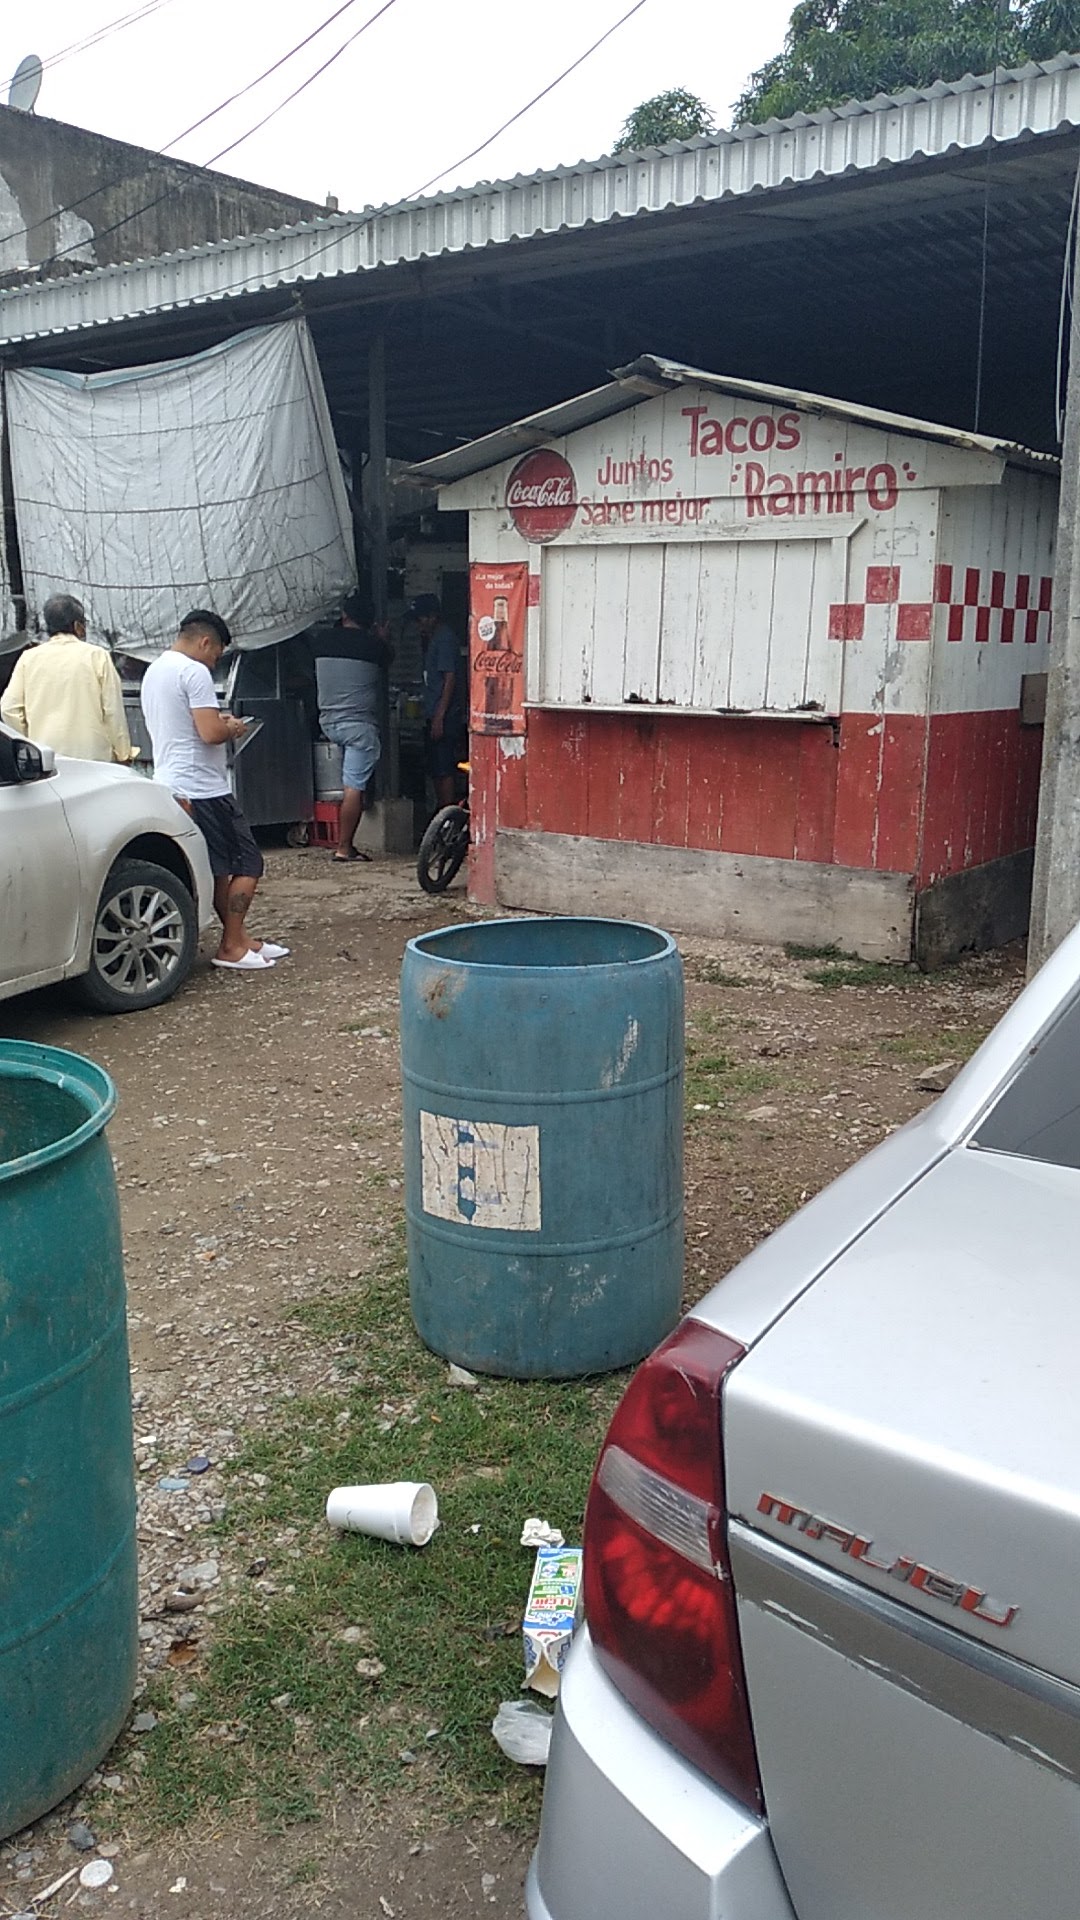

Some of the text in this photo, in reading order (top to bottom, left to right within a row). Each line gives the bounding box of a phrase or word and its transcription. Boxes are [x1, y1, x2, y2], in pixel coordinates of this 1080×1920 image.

[682, 406, 801, 457] Tacos
[597, 453, 673, 486] Juntos
[744, 452, 899, 517] Ramiro
[641, 489, 711, 526] mejor
[756, 1492, 1020, 1627] MALIBU
